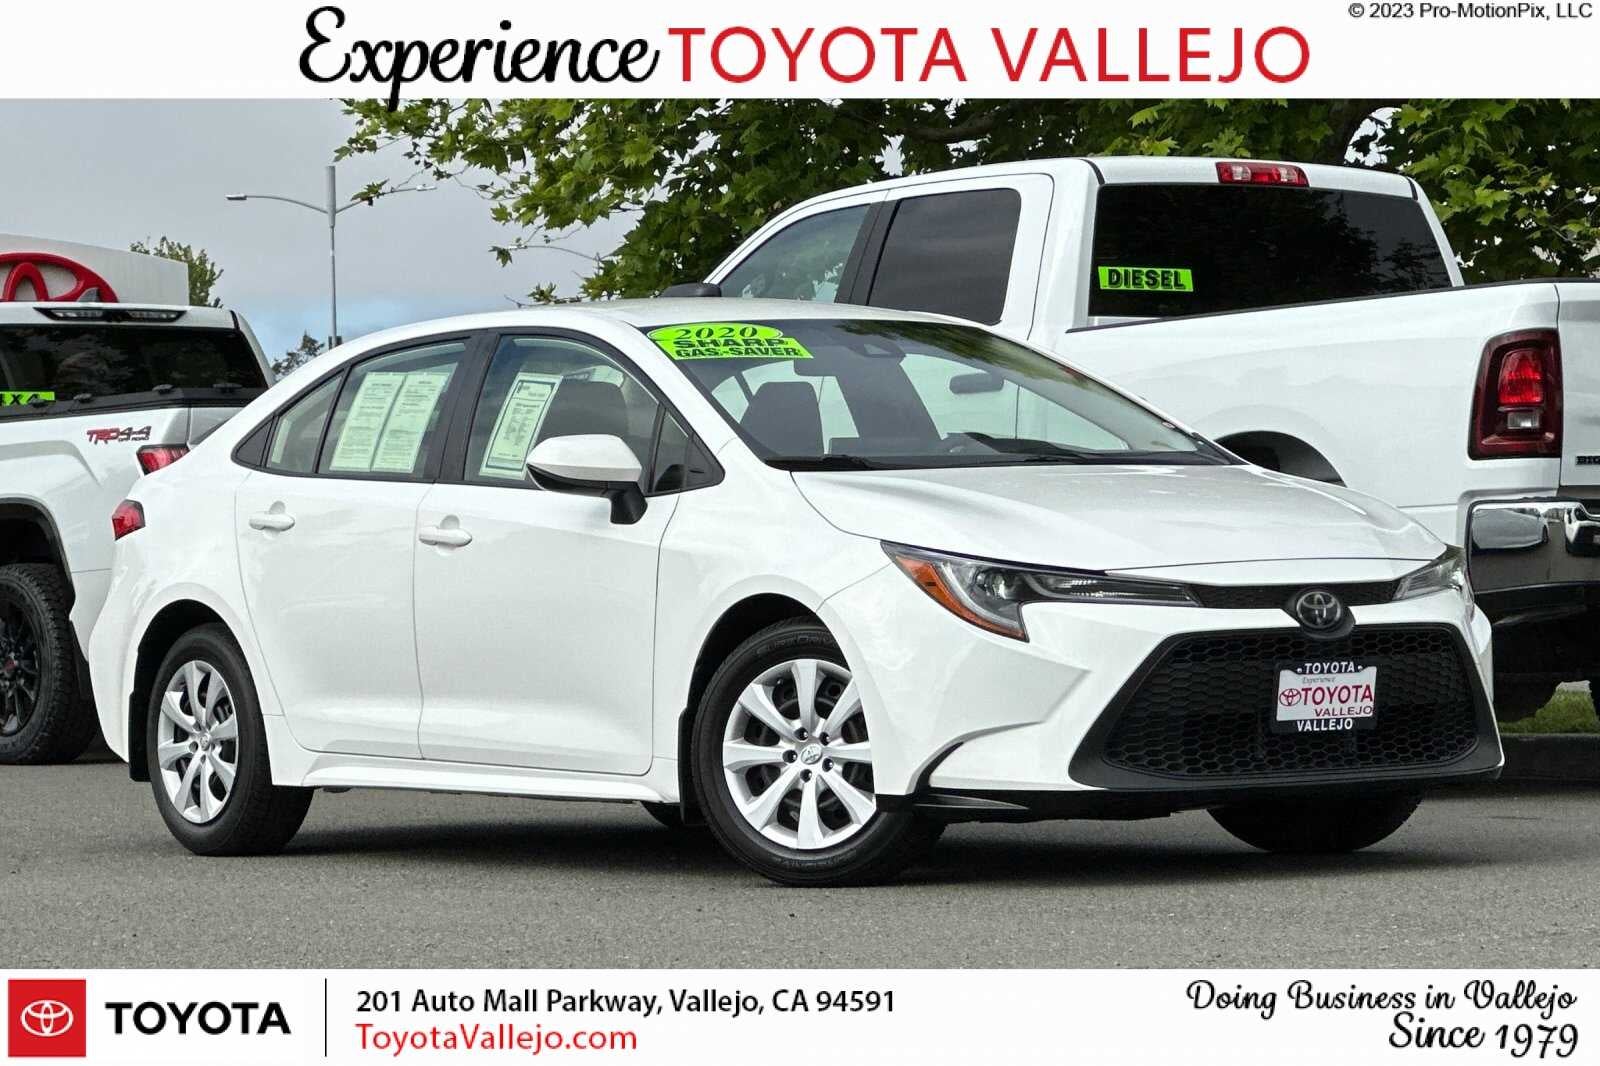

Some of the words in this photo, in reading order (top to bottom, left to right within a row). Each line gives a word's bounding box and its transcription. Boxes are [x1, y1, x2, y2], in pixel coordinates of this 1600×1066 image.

[1107, 268, 1186, 290] DIESEL
[674, 326, 758, 340] 2020
[1305, 662, 1355, 674] TOYOTA
[1301, 684, 1373, 706] TOYOTA
[1314, 705, 1373, 717] VALLEJO
[1296, 718, 1353, 732] VALLEJO
